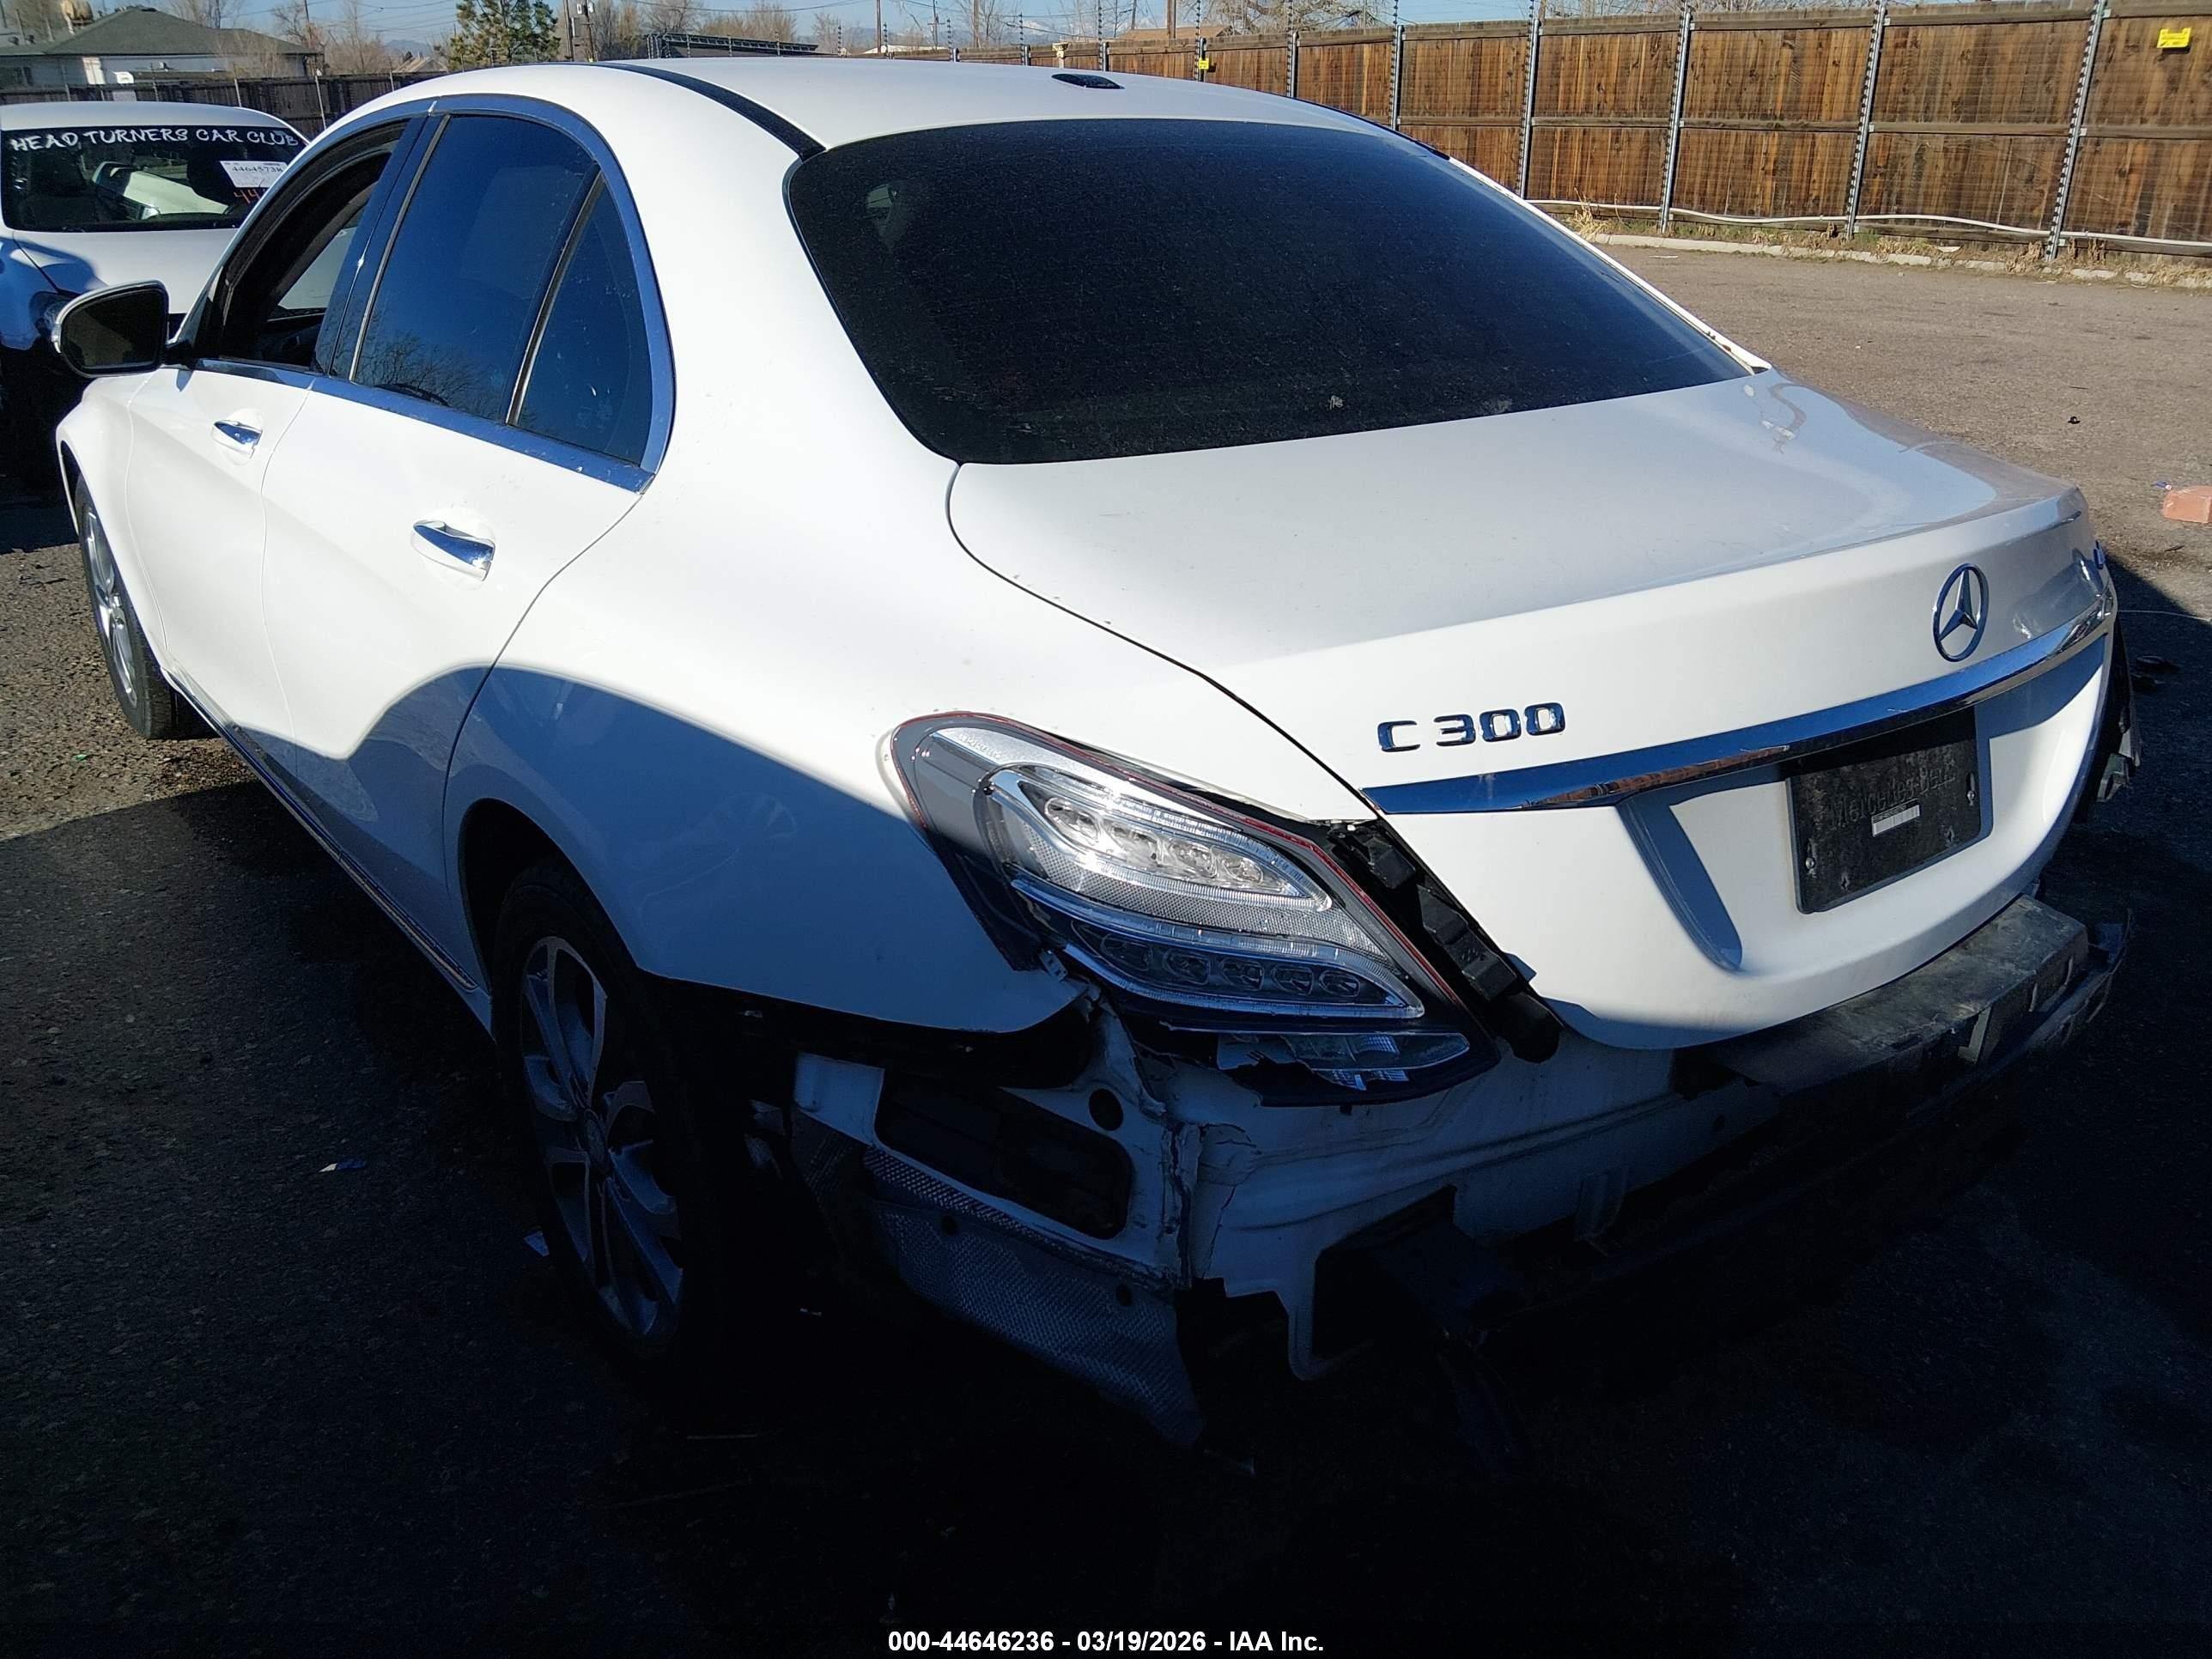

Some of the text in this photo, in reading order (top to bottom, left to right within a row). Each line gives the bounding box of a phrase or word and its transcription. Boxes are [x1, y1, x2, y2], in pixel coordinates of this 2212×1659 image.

[10, 129, 299, 151] HEAD TURNERS CAR CLUB
[1377, 702, 1565, 752] C 300
